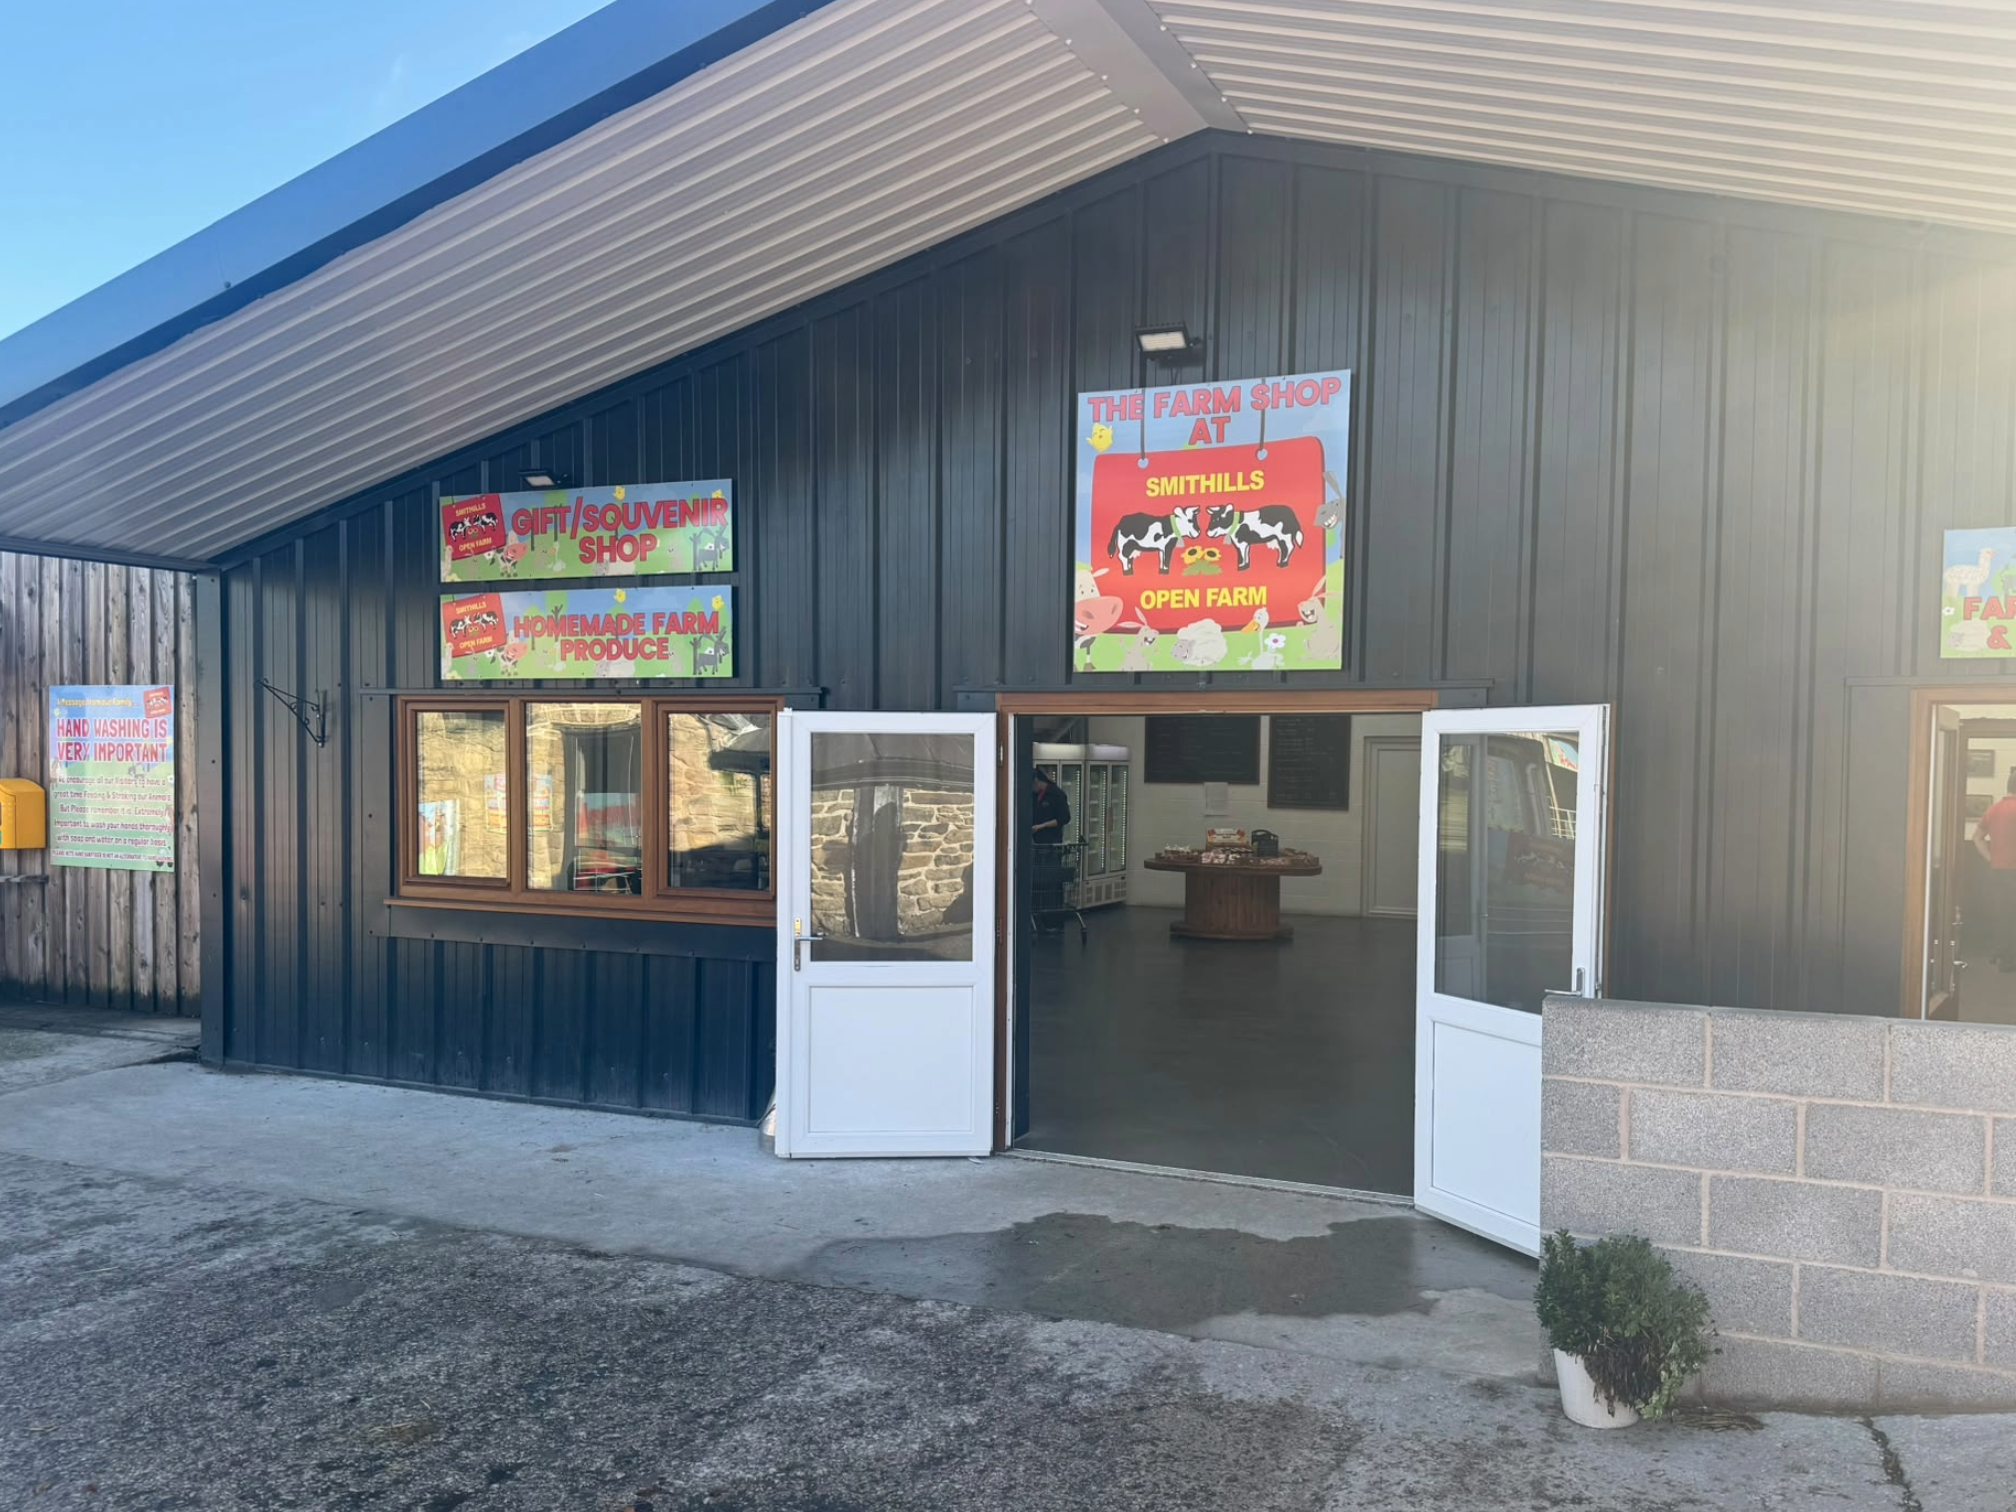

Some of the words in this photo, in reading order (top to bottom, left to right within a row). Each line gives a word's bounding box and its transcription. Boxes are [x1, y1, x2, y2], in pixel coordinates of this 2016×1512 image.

[1087, 393, 1144, 422] THE
[1153, 385, 1241, 419] FARM
[1251, 376, 1342, 411] SHOP
[1188, 415, 1232, 445] AT
[1145, 470, 1265, 497] SMITHILLS
[455, 503, 487, 517] SMITHILLS
[511, 496, 729, 540] GIFT/SOUVENIR
[458, 541, 476, 551] OPEN
[476, 537, 492, 549] FARM
[578, 534, 658, 564] SHOP
[455, 601, 487, 615] SMITHILLS
[1139, 588, 1200, 610] OPEN
[1206, 586, 1267, 607] FARM
[513, 613, 646, 639] HOMEMADE
[653, 611, 720, 635] FARM
[459, 638, 476, 649] OPEN
[477, 635, 493, 646] FARM
[560, 638, 670, 661] PRODUCE
[1987, 625, 2013, 650] &
[57, 719, 90, 737] HAND
[94, 719, 150, 738] WASHING
[154, 719, 168, 738] IS
[57, 742, 90, 761] VERY
[94, 742, 167, 762] IMPORTANT
